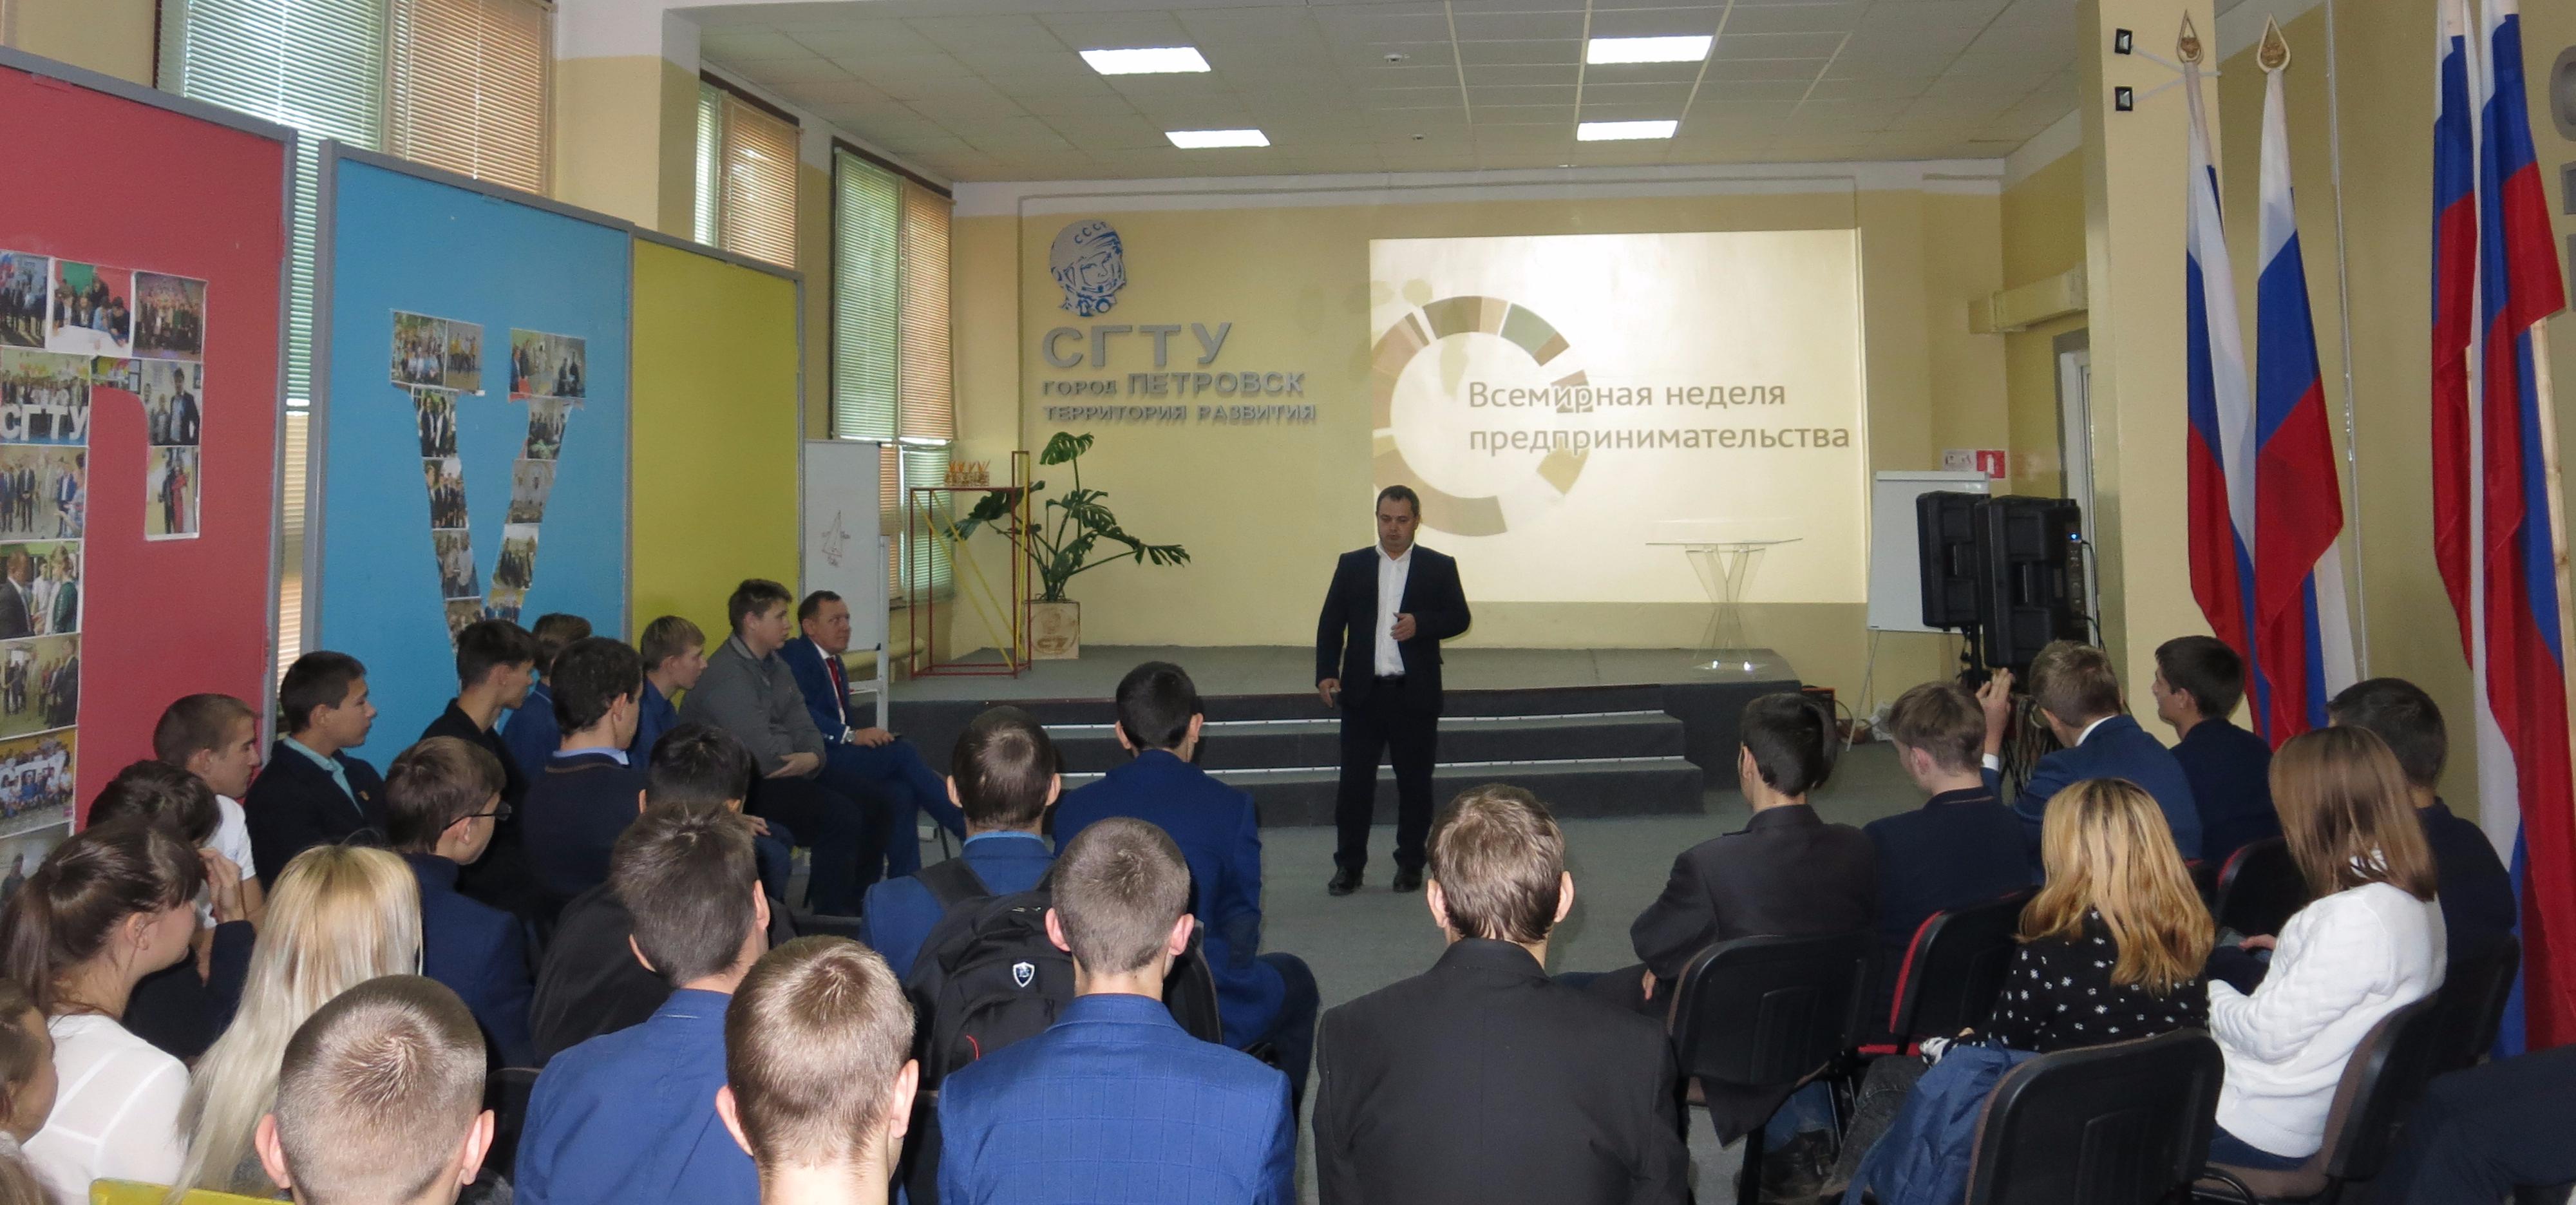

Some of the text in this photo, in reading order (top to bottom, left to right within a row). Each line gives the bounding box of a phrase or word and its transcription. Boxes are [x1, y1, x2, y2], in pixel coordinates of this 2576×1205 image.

[1042, 322, 1232, 368] СГТУ
[1043, 371, 1305, 395] ГОРОД ПЕТРОВСК
[1470, 381, 1786, 413] Всемирная неделя
[0, 404, 89, 441] СГТУ
[1043, 404, 1317, 422] ТЕРРИТОРИЯ РАЗВИТИЯ
[1470, 426, 1850, 457] предпринимательства
